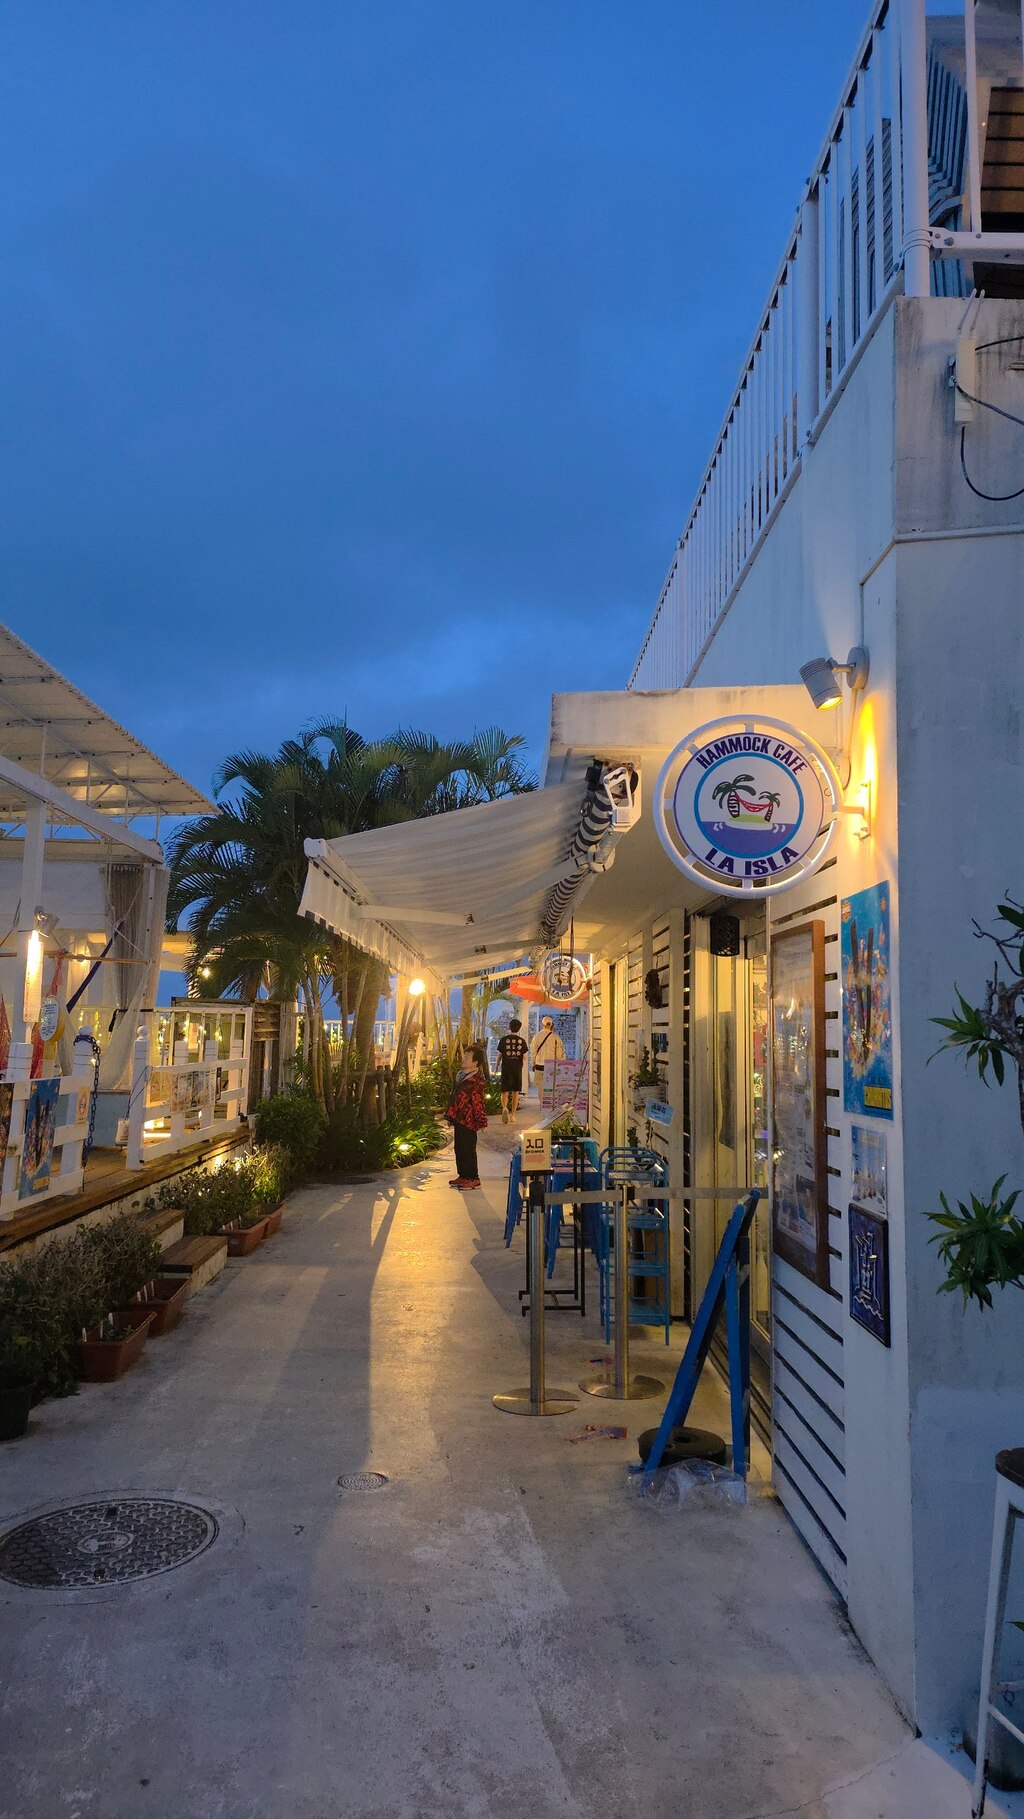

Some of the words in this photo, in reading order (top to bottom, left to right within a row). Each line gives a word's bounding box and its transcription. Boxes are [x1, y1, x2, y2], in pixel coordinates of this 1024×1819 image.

[696, 736, 771, 770] HAMMOCK
[773, 743, 808, 776] CAFE
[704, 847, 734, 874] LA
[745, 846, 799, 876] ISLA
